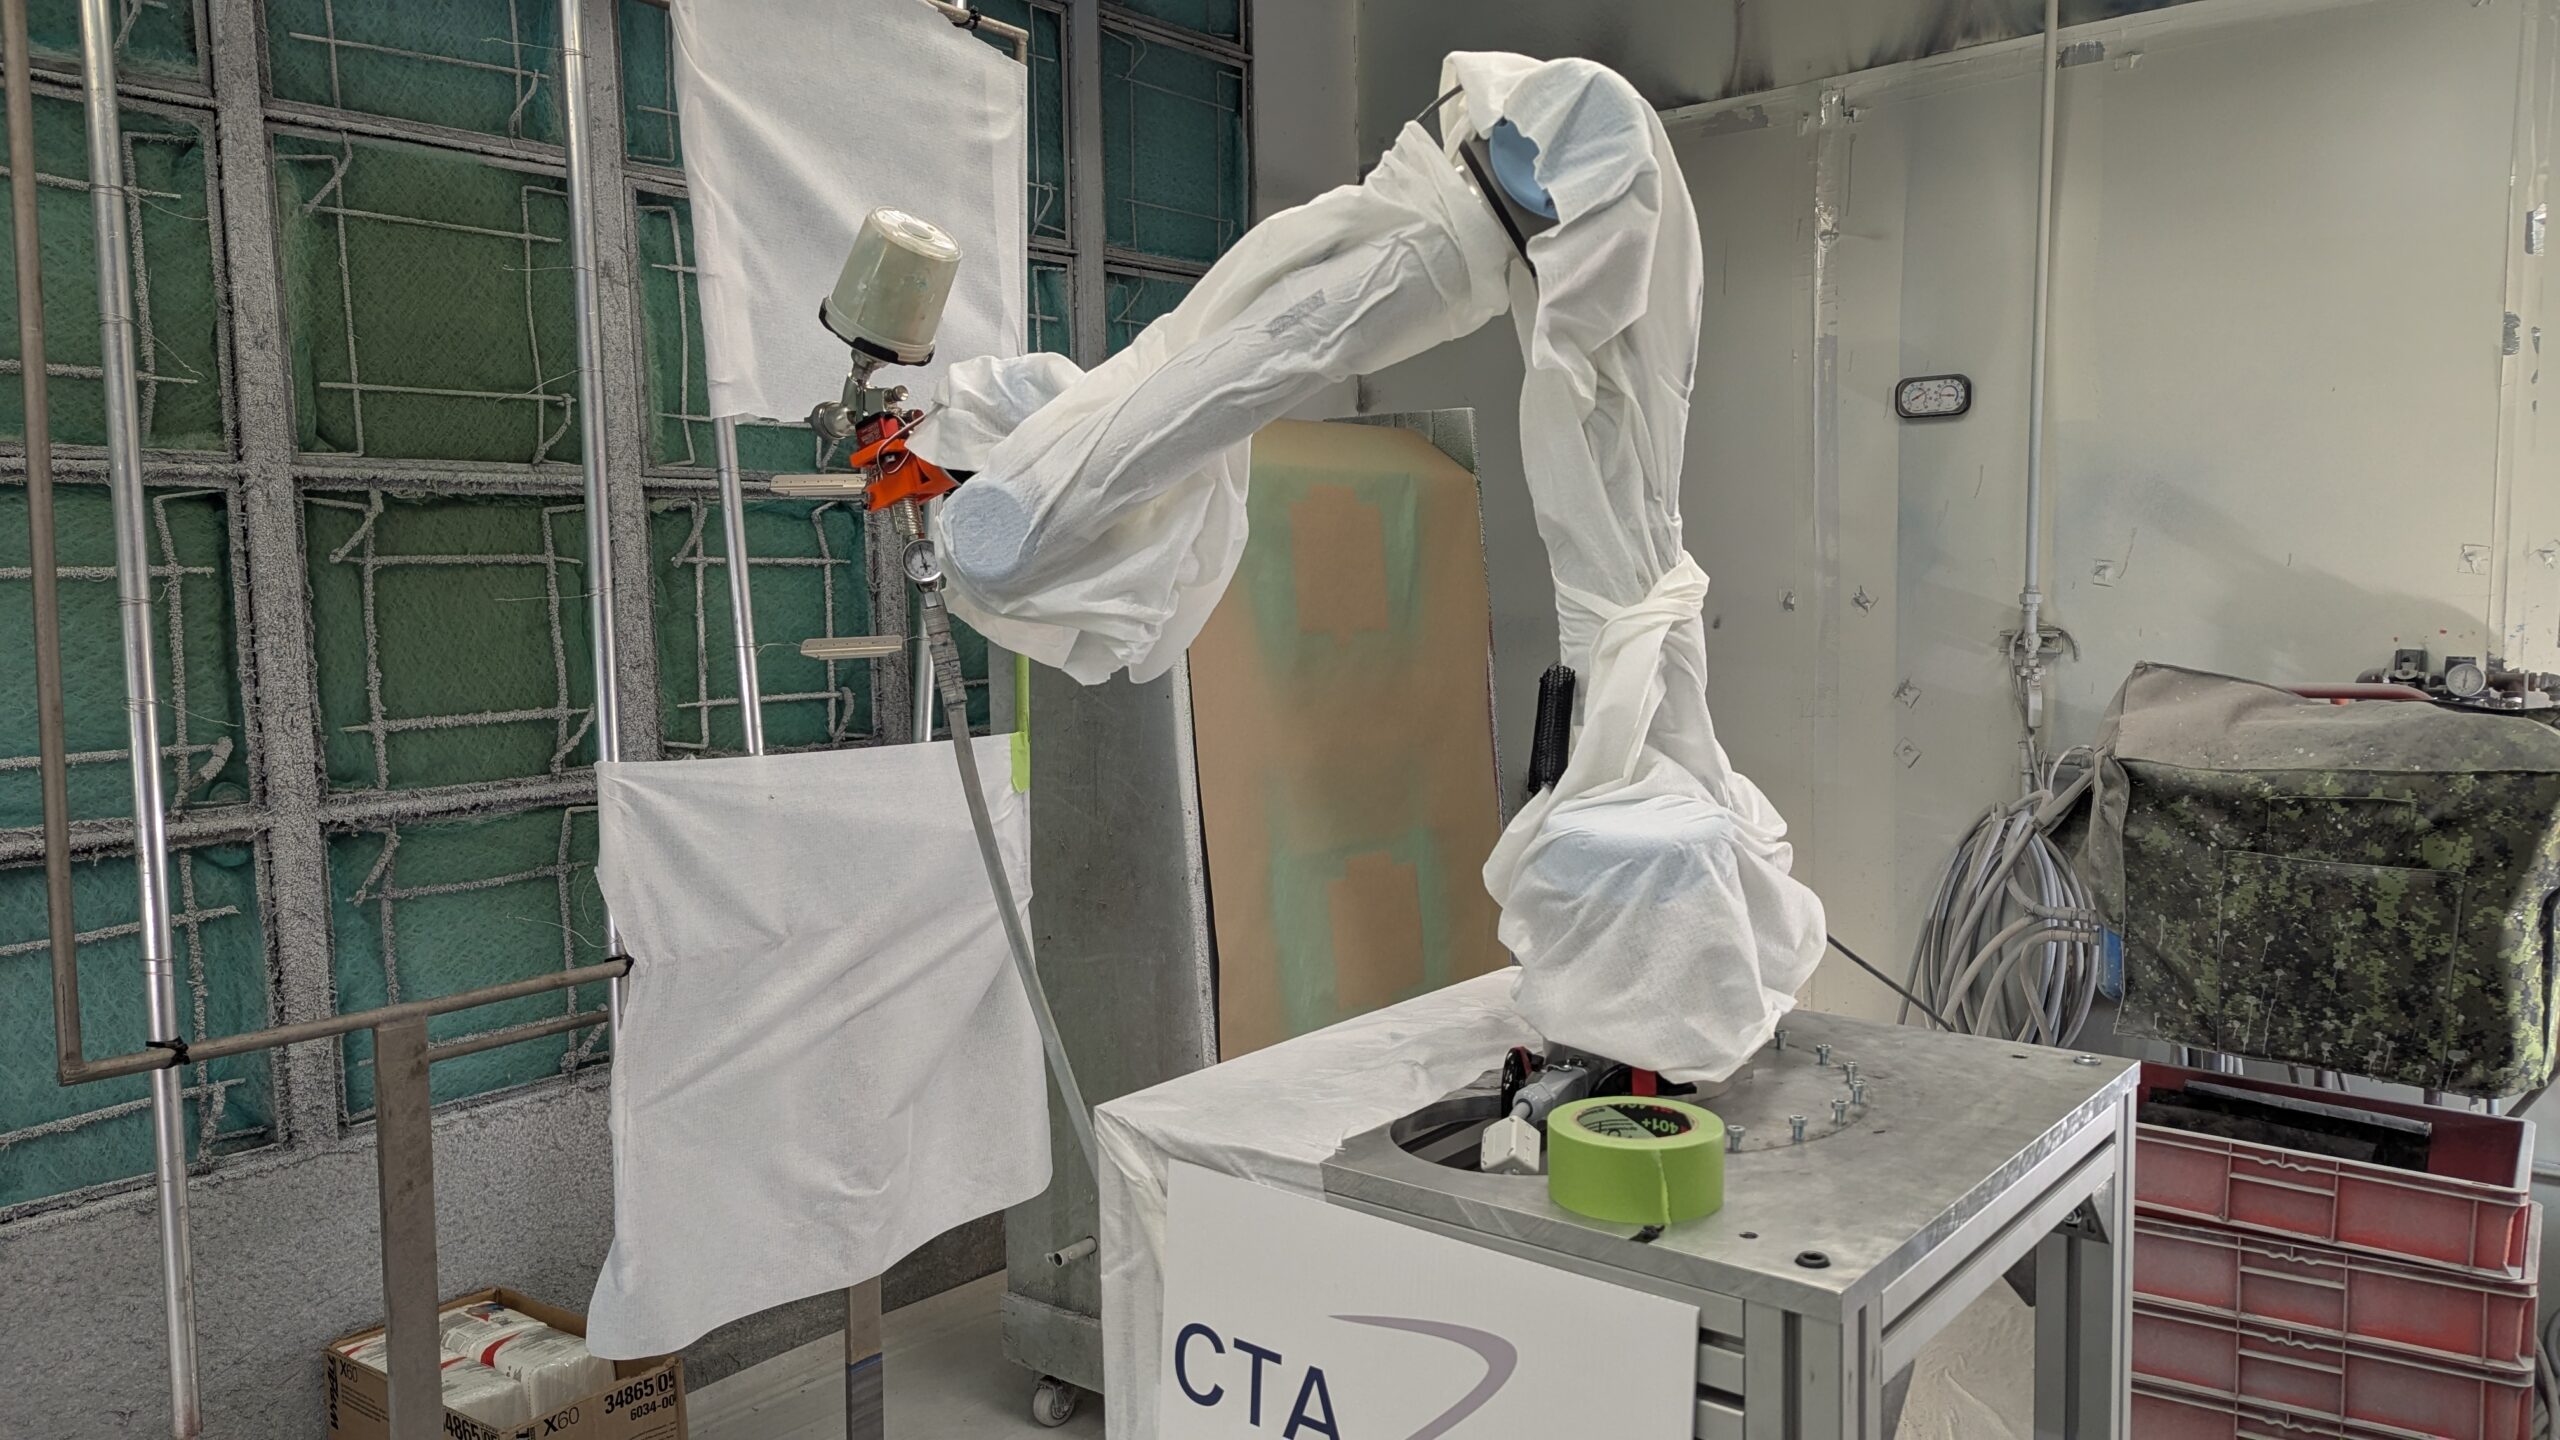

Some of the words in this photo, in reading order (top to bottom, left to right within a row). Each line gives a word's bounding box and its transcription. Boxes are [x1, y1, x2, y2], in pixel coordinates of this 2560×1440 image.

[1641, 1118, 1678, 1134] 401+
[340, 1359, 358, 1383] X60
[1174, 1322, 1340, 1440] CTA
[603, 1377, 655, 1415] 34865
[630, 1394, 677, 1421] 6034-00
[442, 1412, 481, 1440] 4865
[543, 1406, 580, 1437] X60
